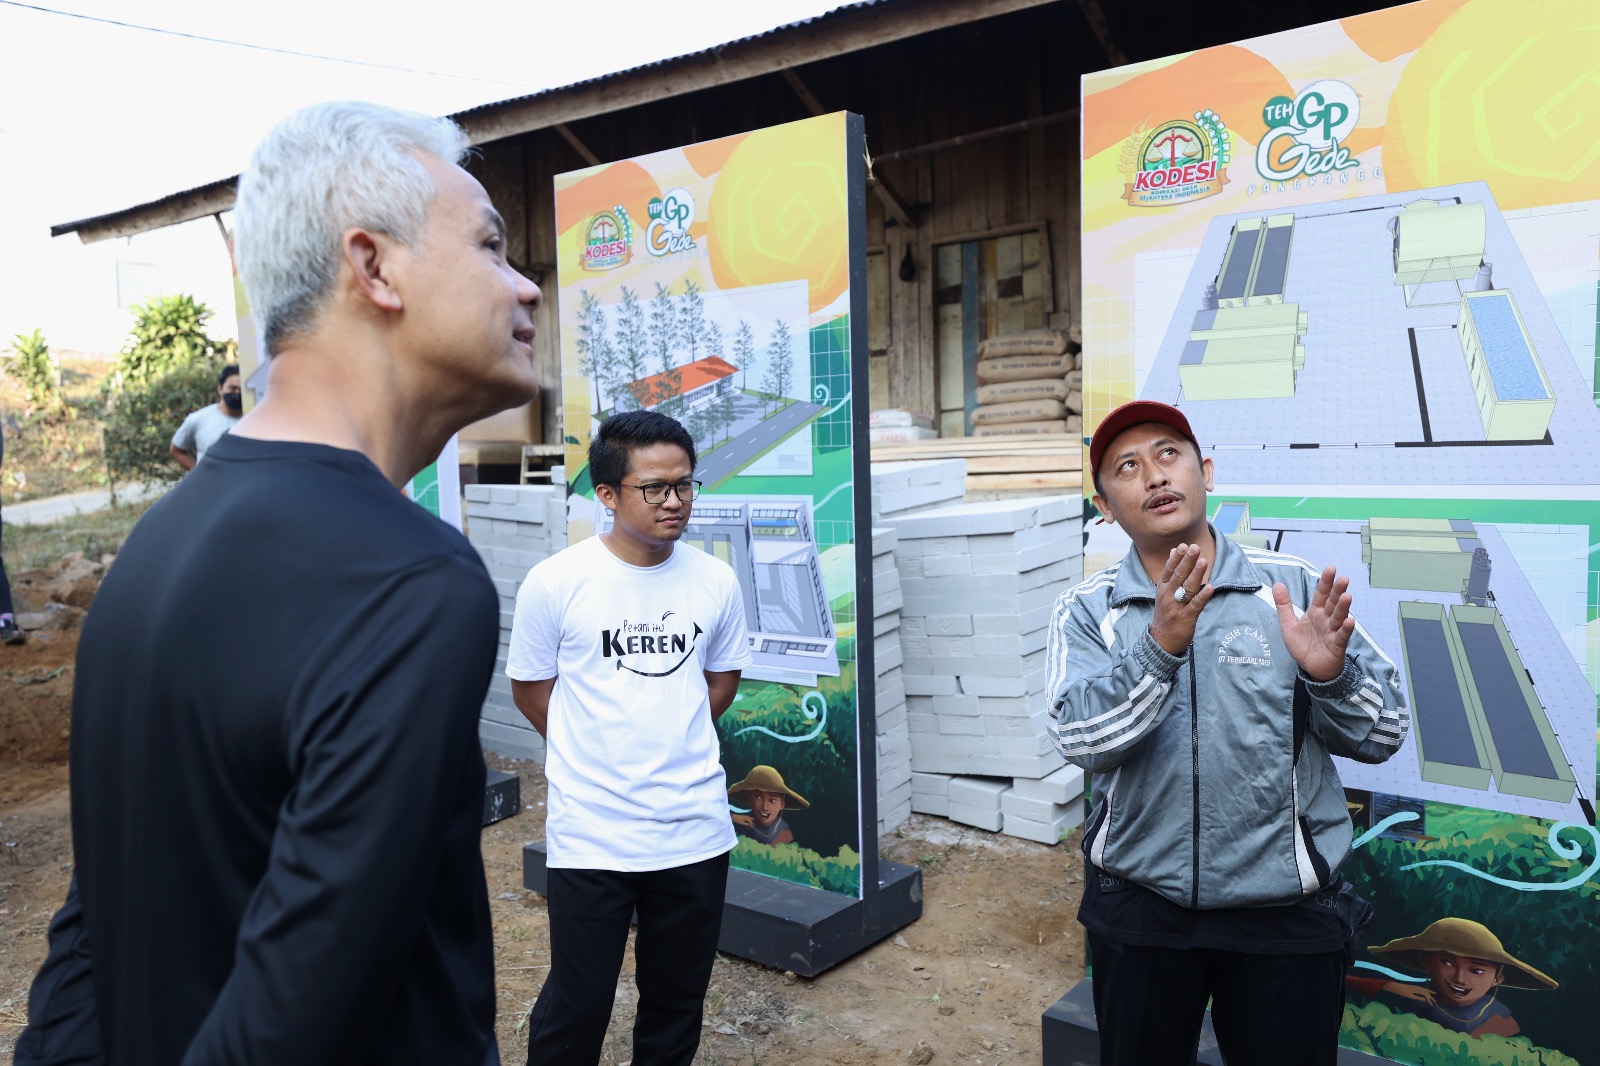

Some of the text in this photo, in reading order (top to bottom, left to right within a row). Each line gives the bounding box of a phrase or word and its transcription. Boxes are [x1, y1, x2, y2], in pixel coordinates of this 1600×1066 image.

[1264, 91, 1349, 141] TEH GP
[1256, 125, 1360, 181] Gede
[1133, 160, 1217, 191] KODESI
[1181, 184, 1198, 192] DESA
[1247, 167, 1382, 196] PANGRANGO
[1174, 185, 1211, 199] INDONESIA
[648, 196, 690, 230] TEH GP
[585, 240, 627, 260] KODESI
[646, 217, 697, 257] Gede
[623, 619, 665, 634] Petani itu
[1218, 628, 1242, 654] PASIR
[602, 628, 686, 658] KEREN
